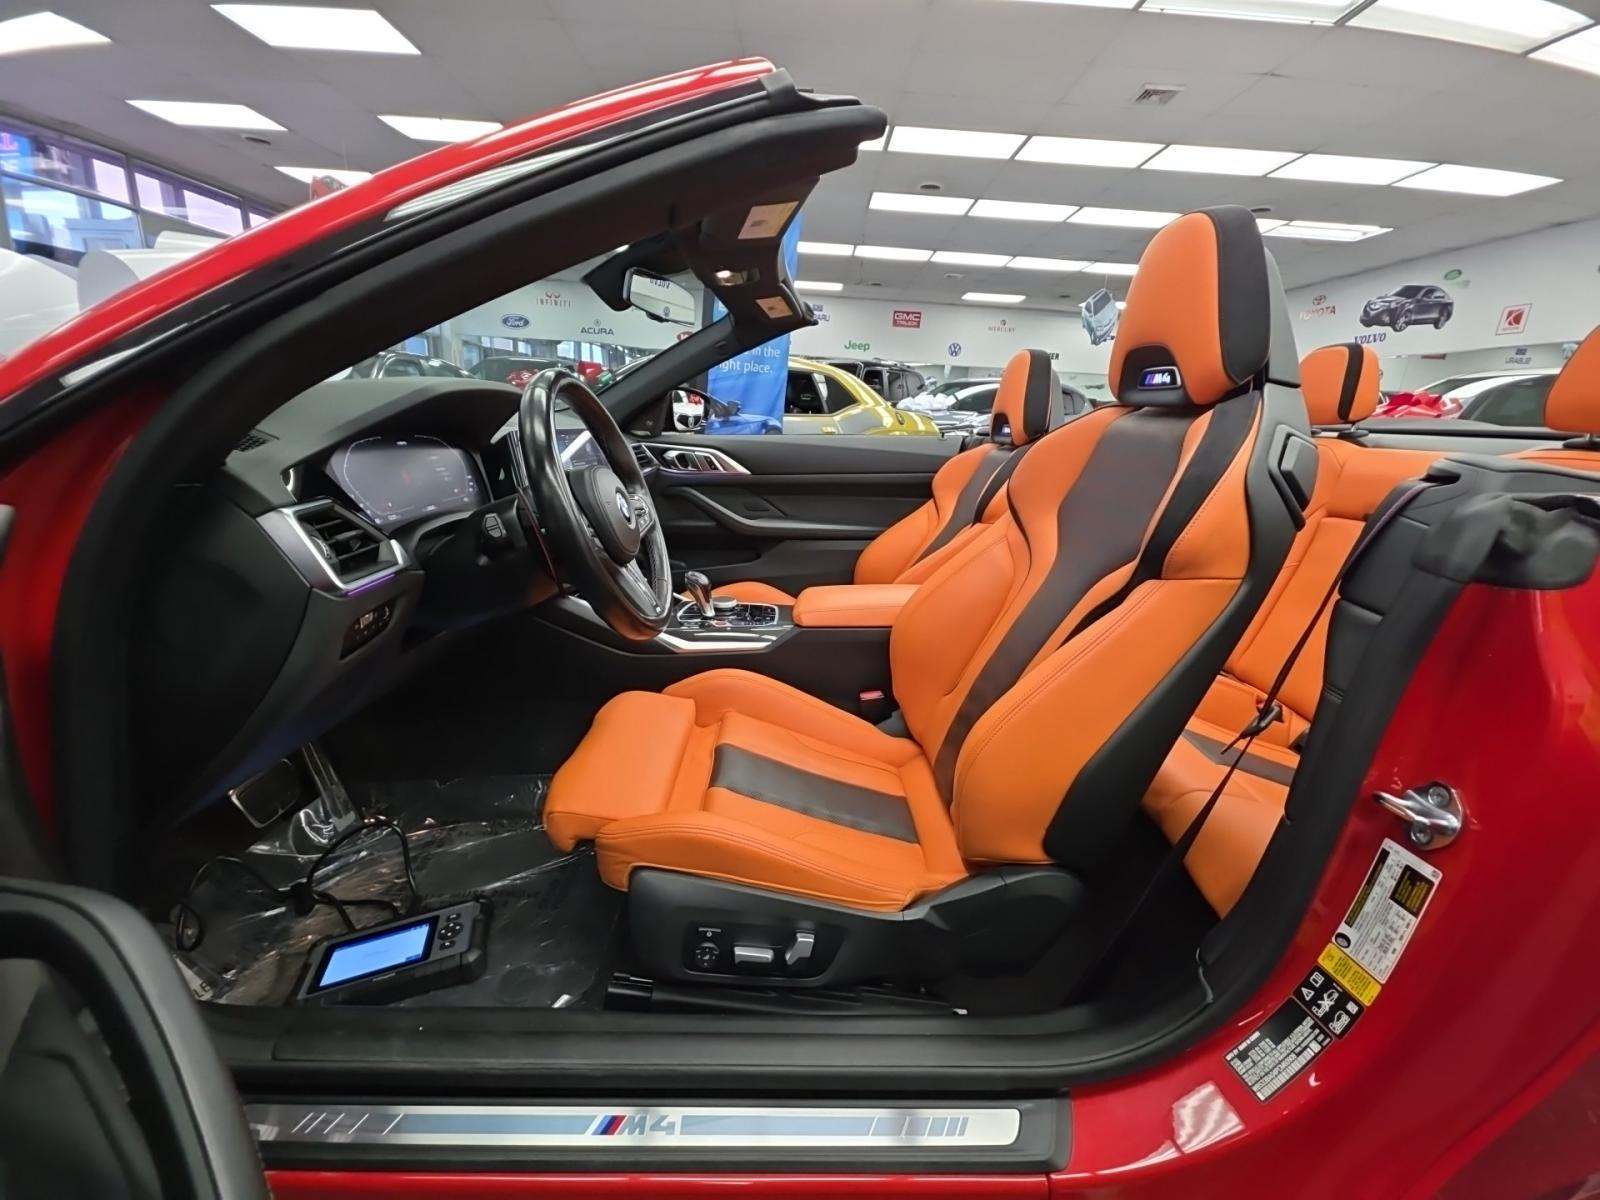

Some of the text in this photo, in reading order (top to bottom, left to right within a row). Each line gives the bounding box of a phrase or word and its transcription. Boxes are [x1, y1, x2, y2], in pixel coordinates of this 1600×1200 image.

[894, 312, 921, 321] GMC
[580, 326, 615, 336] ACURA
[1354, 332, 1387, 345] VOLVO
[763, 346, 781, 358] the
[844, 340, 871, 352] Jeep
[743, 360, 773, 374] place.
[617, 1114, 677, 1136] M4
